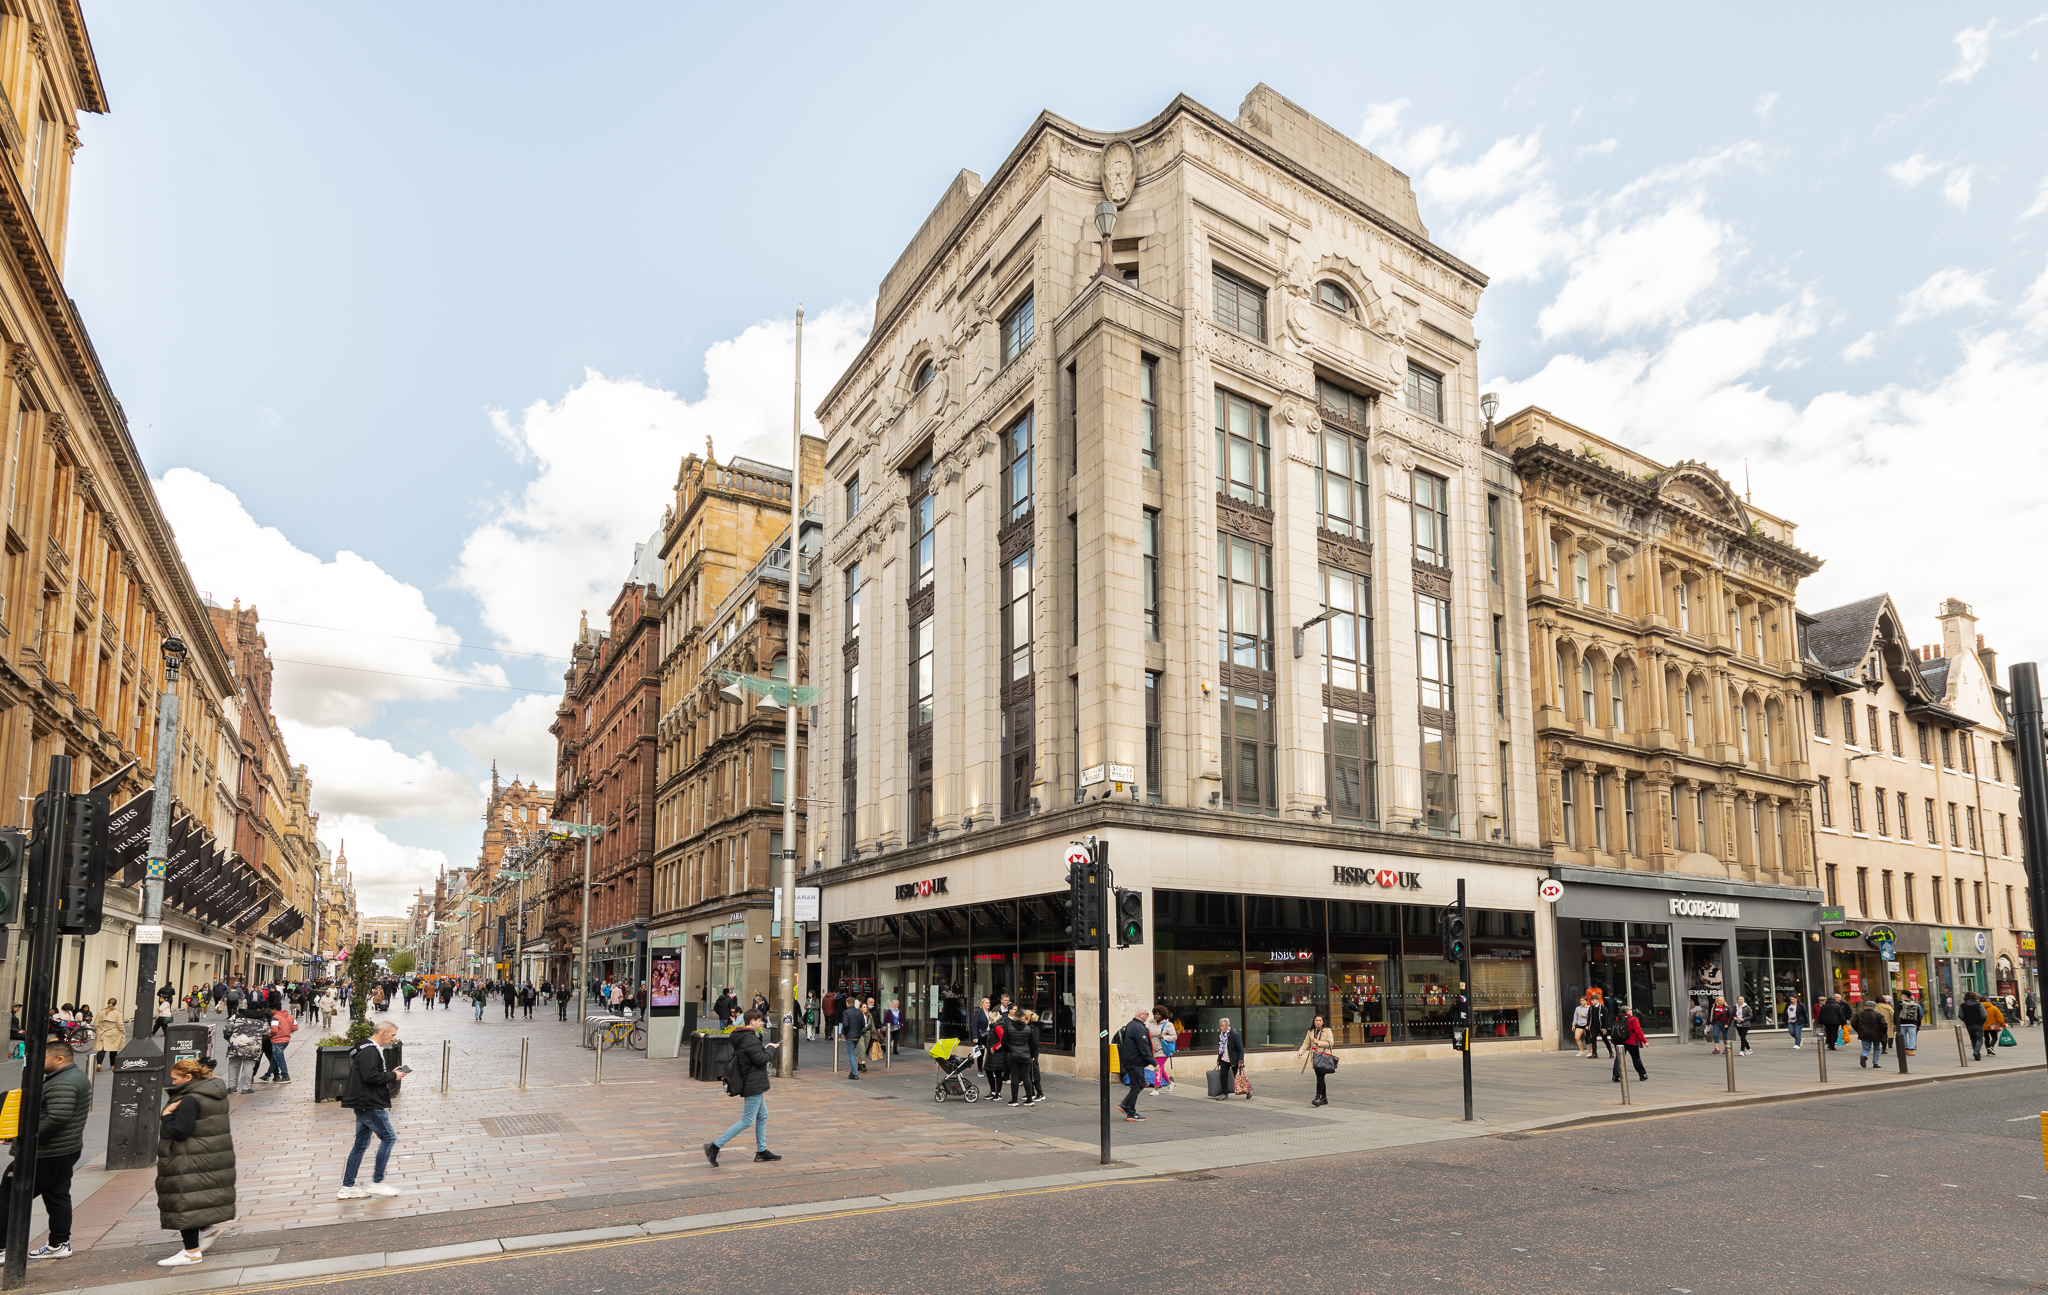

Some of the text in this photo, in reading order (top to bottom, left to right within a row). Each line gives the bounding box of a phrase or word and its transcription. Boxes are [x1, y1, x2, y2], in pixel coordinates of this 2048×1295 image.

[108, 808, 138, 834] ASERS
[1333, 865, 1422, 889] HSBC UK
[895, 876, 948, 900] HSBC UK
[241, 906, 262, 923] FRASERS
[730, 912, 743, 921] ZARA
[1669, 898, 1740, 918] FOOTASYLUM
[2021, 938, 2036, 950] COS
[1270, 948, 1296, 960] HSBC
